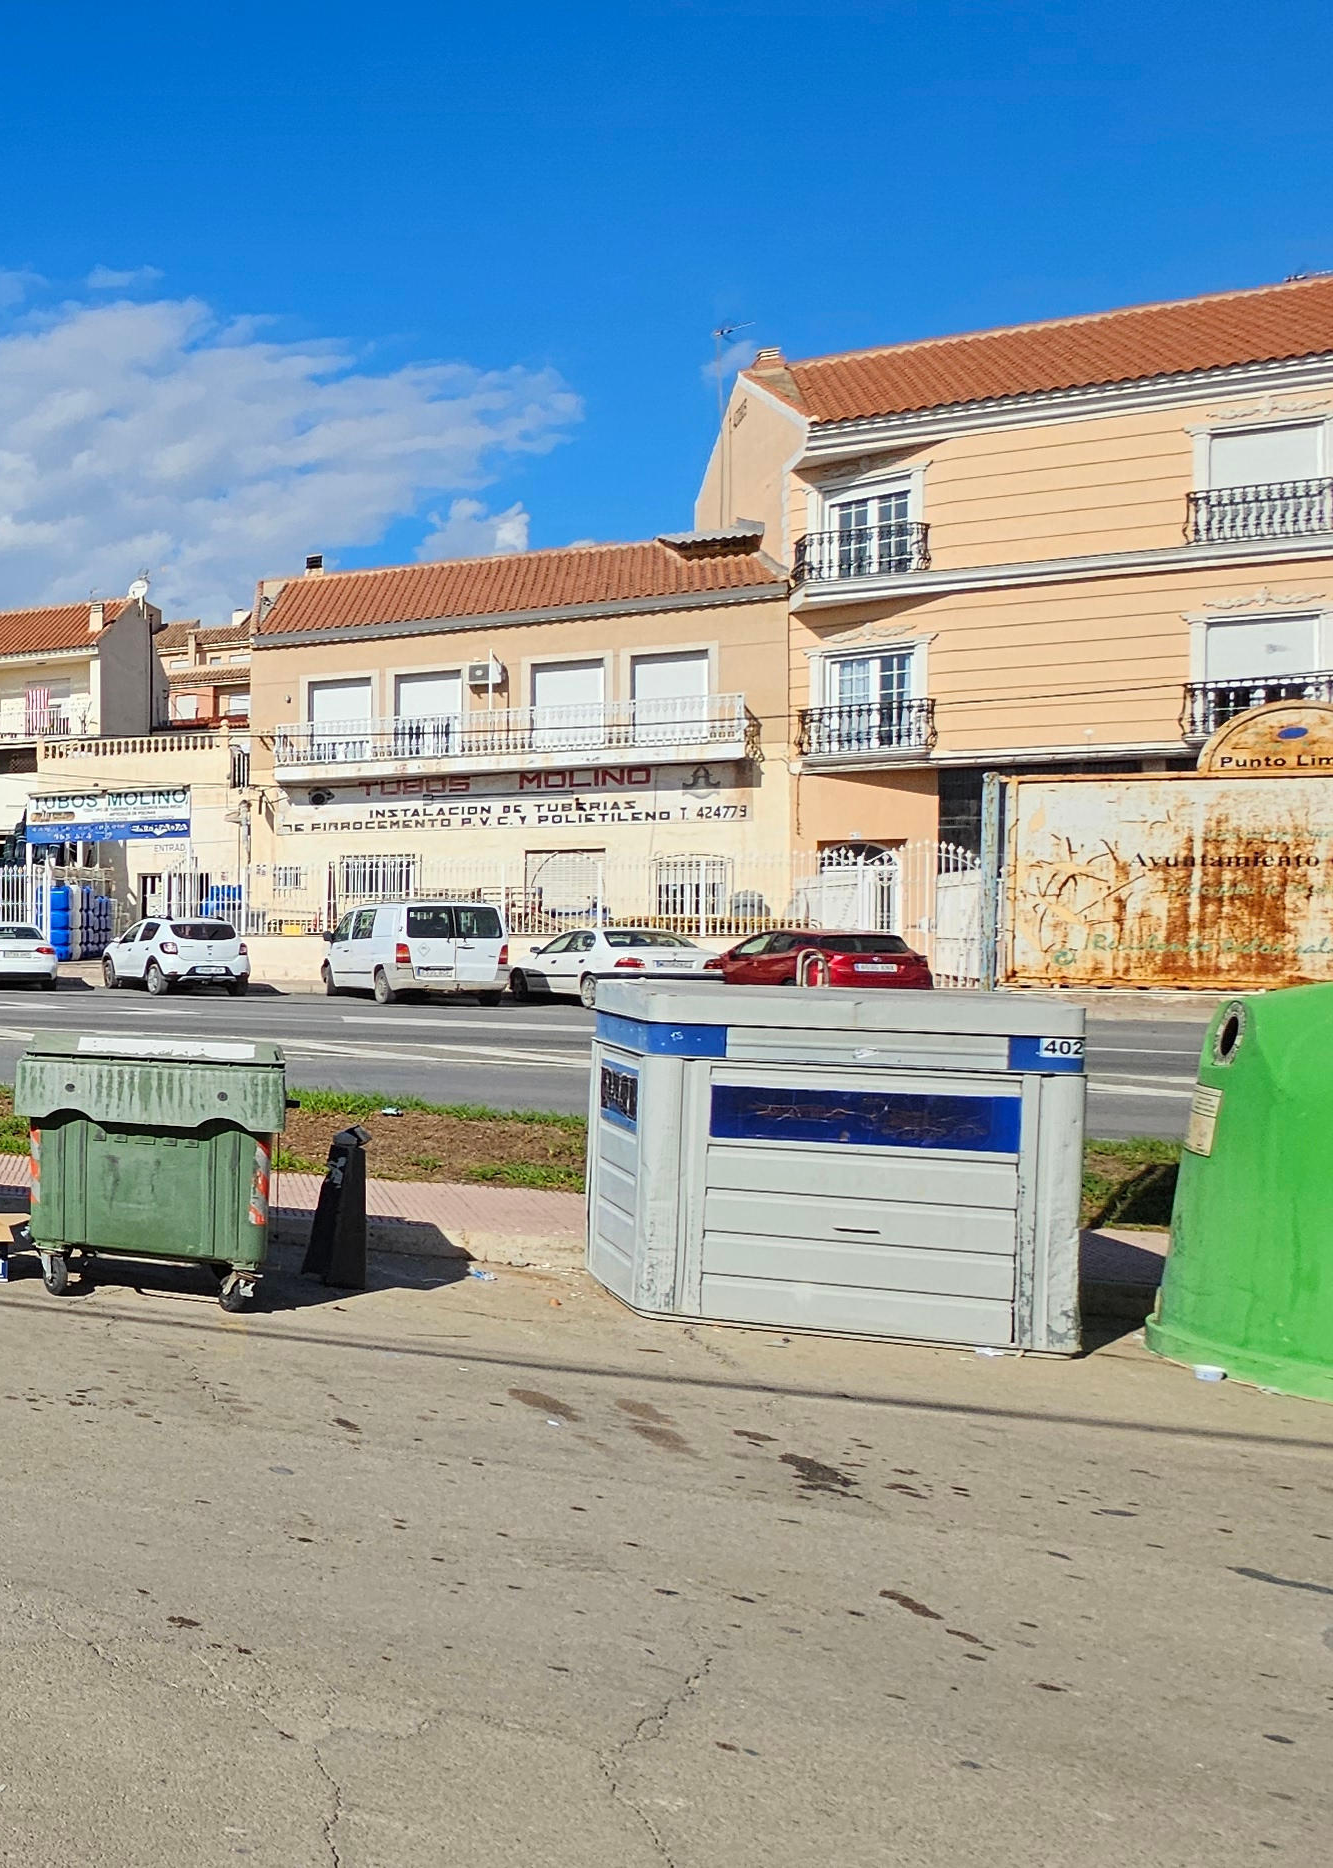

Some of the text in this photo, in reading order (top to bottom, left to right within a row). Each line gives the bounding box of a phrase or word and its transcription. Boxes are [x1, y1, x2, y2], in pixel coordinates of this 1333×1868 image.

[1220, 756, 1287, 768] Punto
[358, 766, 651, 796] TUBOS MOLINO
[34, 789, 187, 810] TUBOS MOLINO
[369, 800, 637, 819] INSTALACION DE TUBERIAS
[519, 816, 527, 825] Y
[537, 811, 671, 824] POLIETILENO
[1129, 851, 1321, 868] Ayuntamiento
[1044, 1039, 1084, 1055] 402
